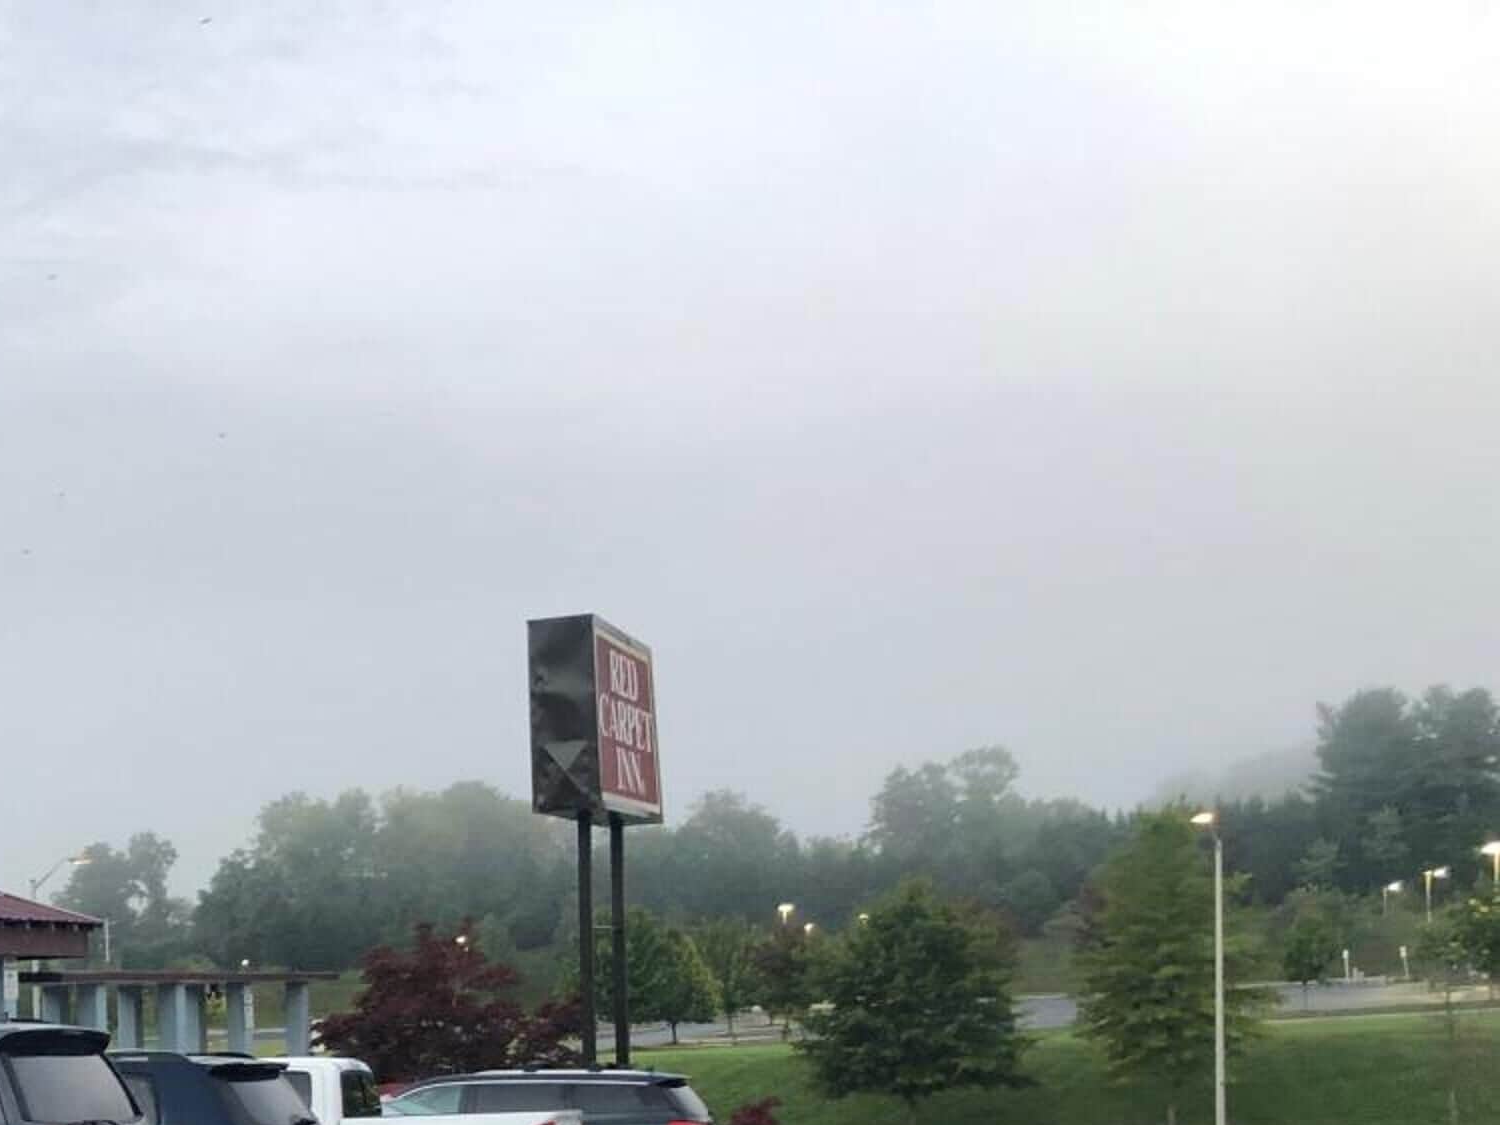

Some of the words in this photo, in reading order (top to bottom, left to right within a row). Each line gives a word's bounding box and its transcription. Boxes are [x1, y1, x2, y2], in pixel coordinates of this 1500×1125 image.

[609, 649, 639, 701] RED
[599, 692, 653, 752] CARPET
[615, 746, 647, 797] INN
